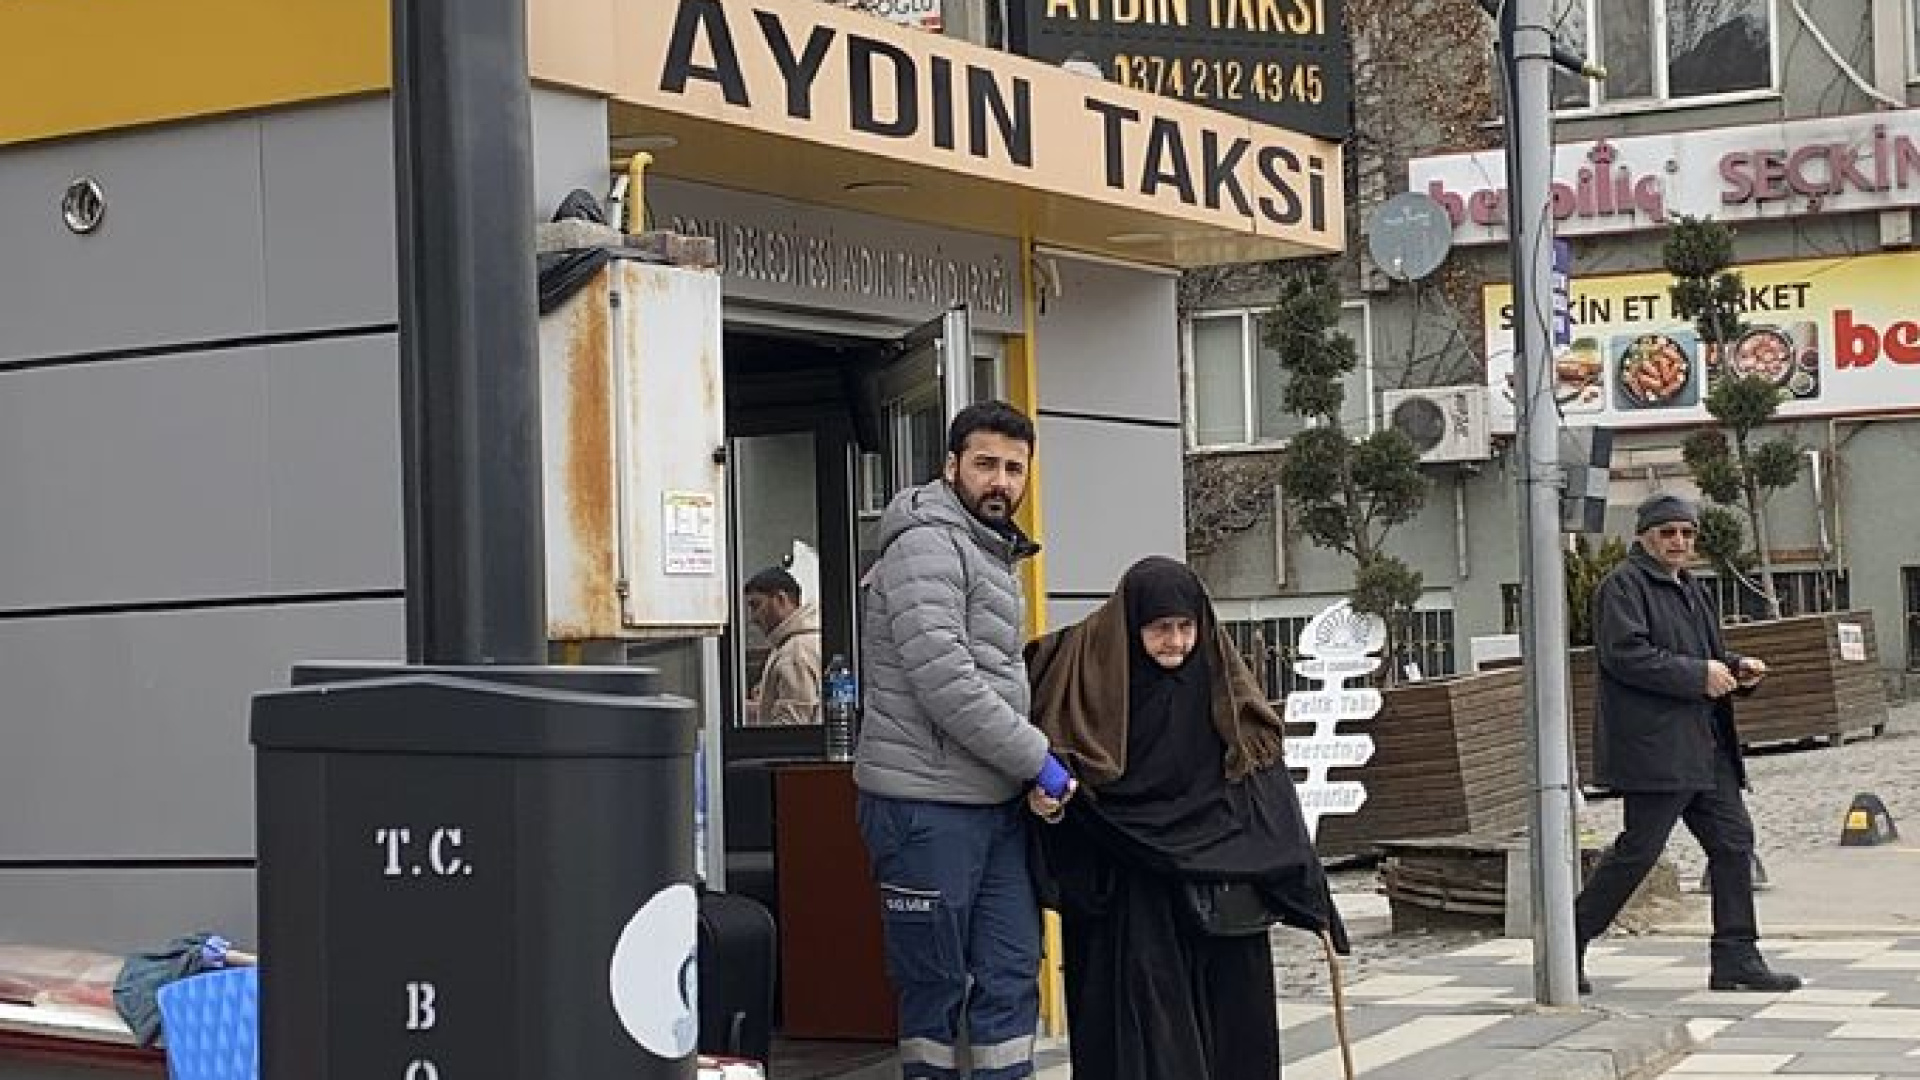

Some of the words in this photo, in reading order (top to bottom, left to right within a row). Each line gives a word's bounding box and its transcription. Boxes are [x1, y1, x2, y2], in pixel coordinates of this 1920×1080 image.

[660, 0, 1032, 168] AYDIN
[1191, 57, 1242, 100] 212
[1250, 61, 1283, 102] 43
[1290, 64, 1322, 104] 45
[1624, 295, 1659, 321] ET
[376, 829, 472, 875] T.C.
